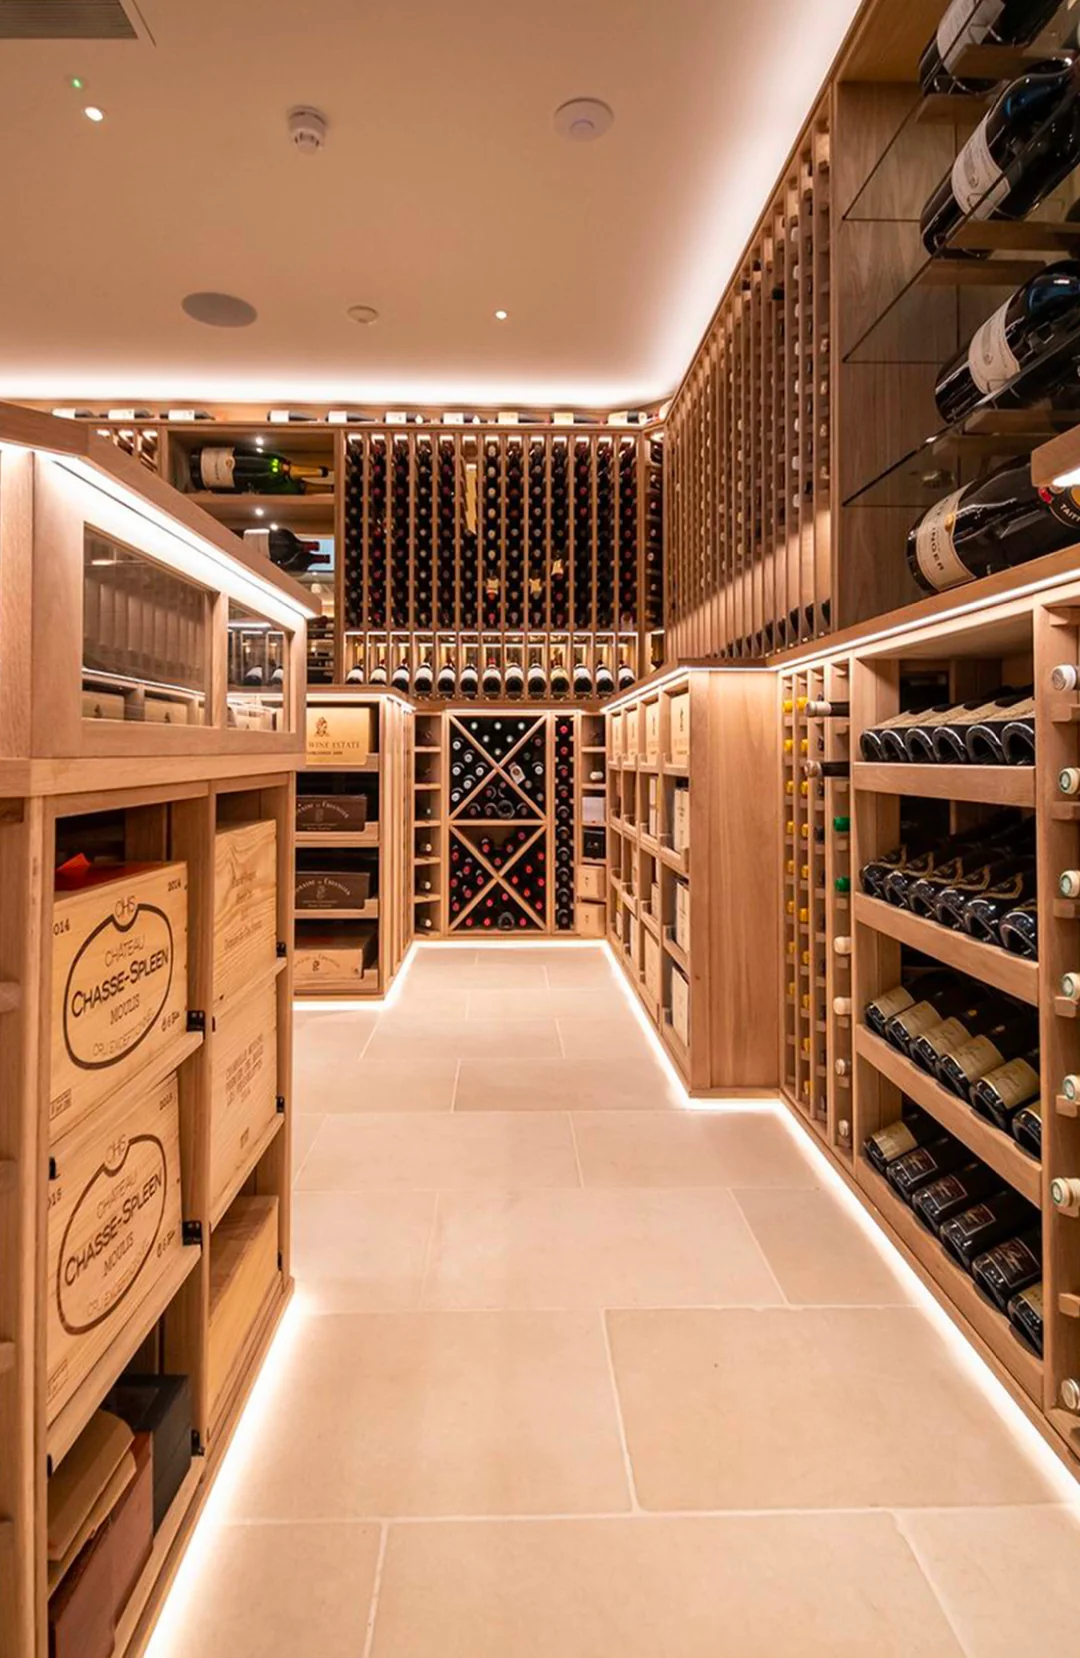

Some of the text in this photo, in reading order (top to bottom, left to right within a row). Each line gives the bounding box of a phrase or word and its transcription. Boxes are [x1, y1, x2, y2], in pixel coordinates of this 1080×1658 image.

[332, 741, 360, 749] ESTATE
[53, 918, 70, 936] 014
[71, 947, 169, 1018] CHASSE-SPLEEN
[64, 1168, 162, 1286] CHASSE-SPLEEN
